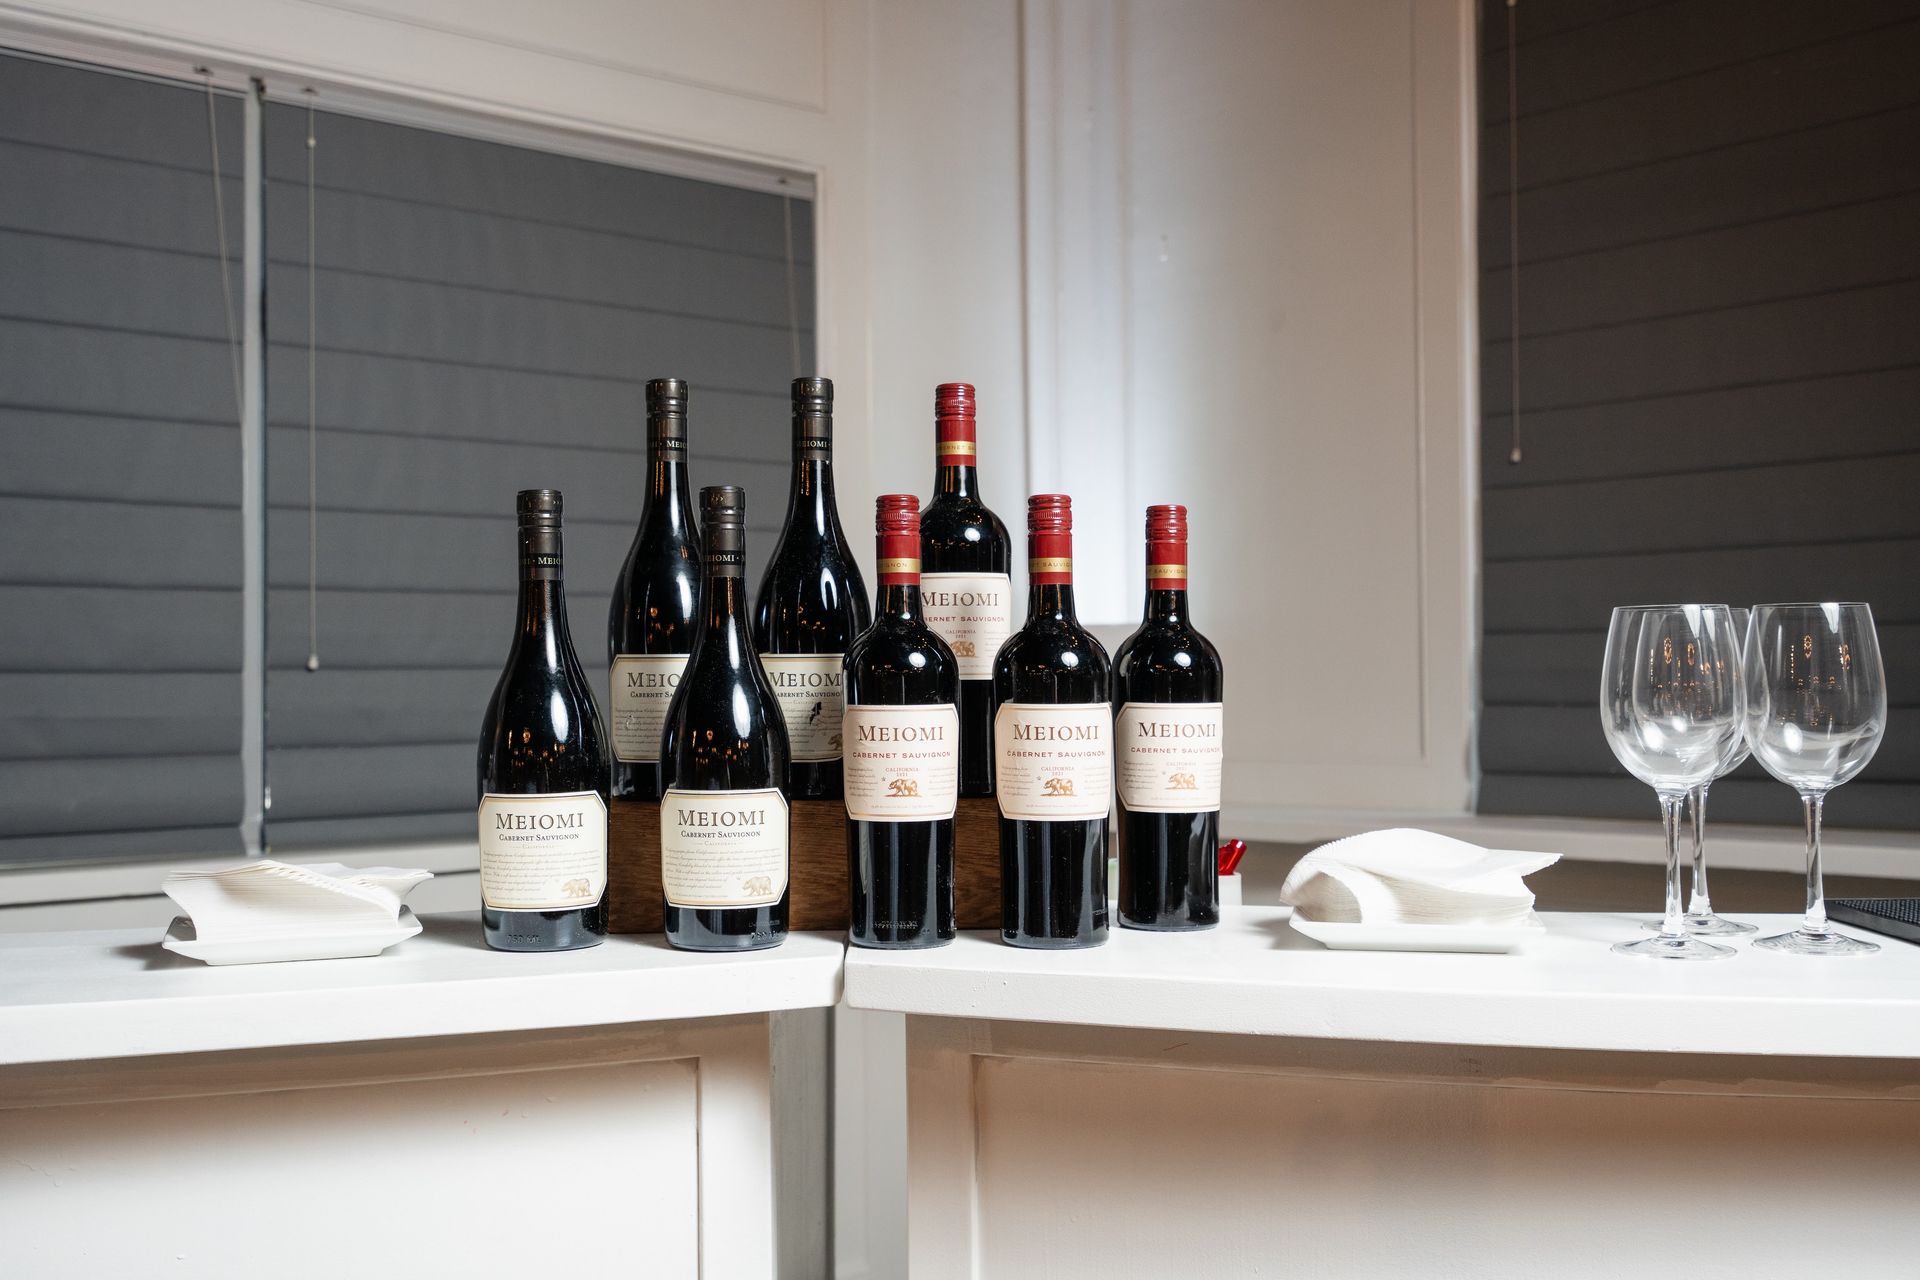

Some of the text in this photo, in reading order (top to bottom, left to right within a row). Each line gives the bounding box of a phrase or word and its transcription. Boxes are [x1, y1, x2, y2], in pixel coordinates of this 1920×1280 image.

[666, 440, 687, 449] MEIO
[537, 556, 561, 565] MEIO
[922, 592, 998, 607] MEIOMI
[627, 672, 681, 688] MEIO
[769, 672, 841, 688] MEIOM
[858, 725, 944, 742] MEIOMI
[1013, 724, 1099, 741] MEIOMI
[1138, 722, 1216, 738] MEIOMI
[902, 751, 951, 759] SAUVIGNON
[1007, 750, 1105, 758] CABERNET SAUVIGNON
[495, 813, 584, 830] MEIOMI
[677, 809, 765, 827] MEIOMI
[498, 833, 580, 842] CABERNET SAUVIGNON
[680, 830, 761, 839] CABERNET SAUVIGNON
